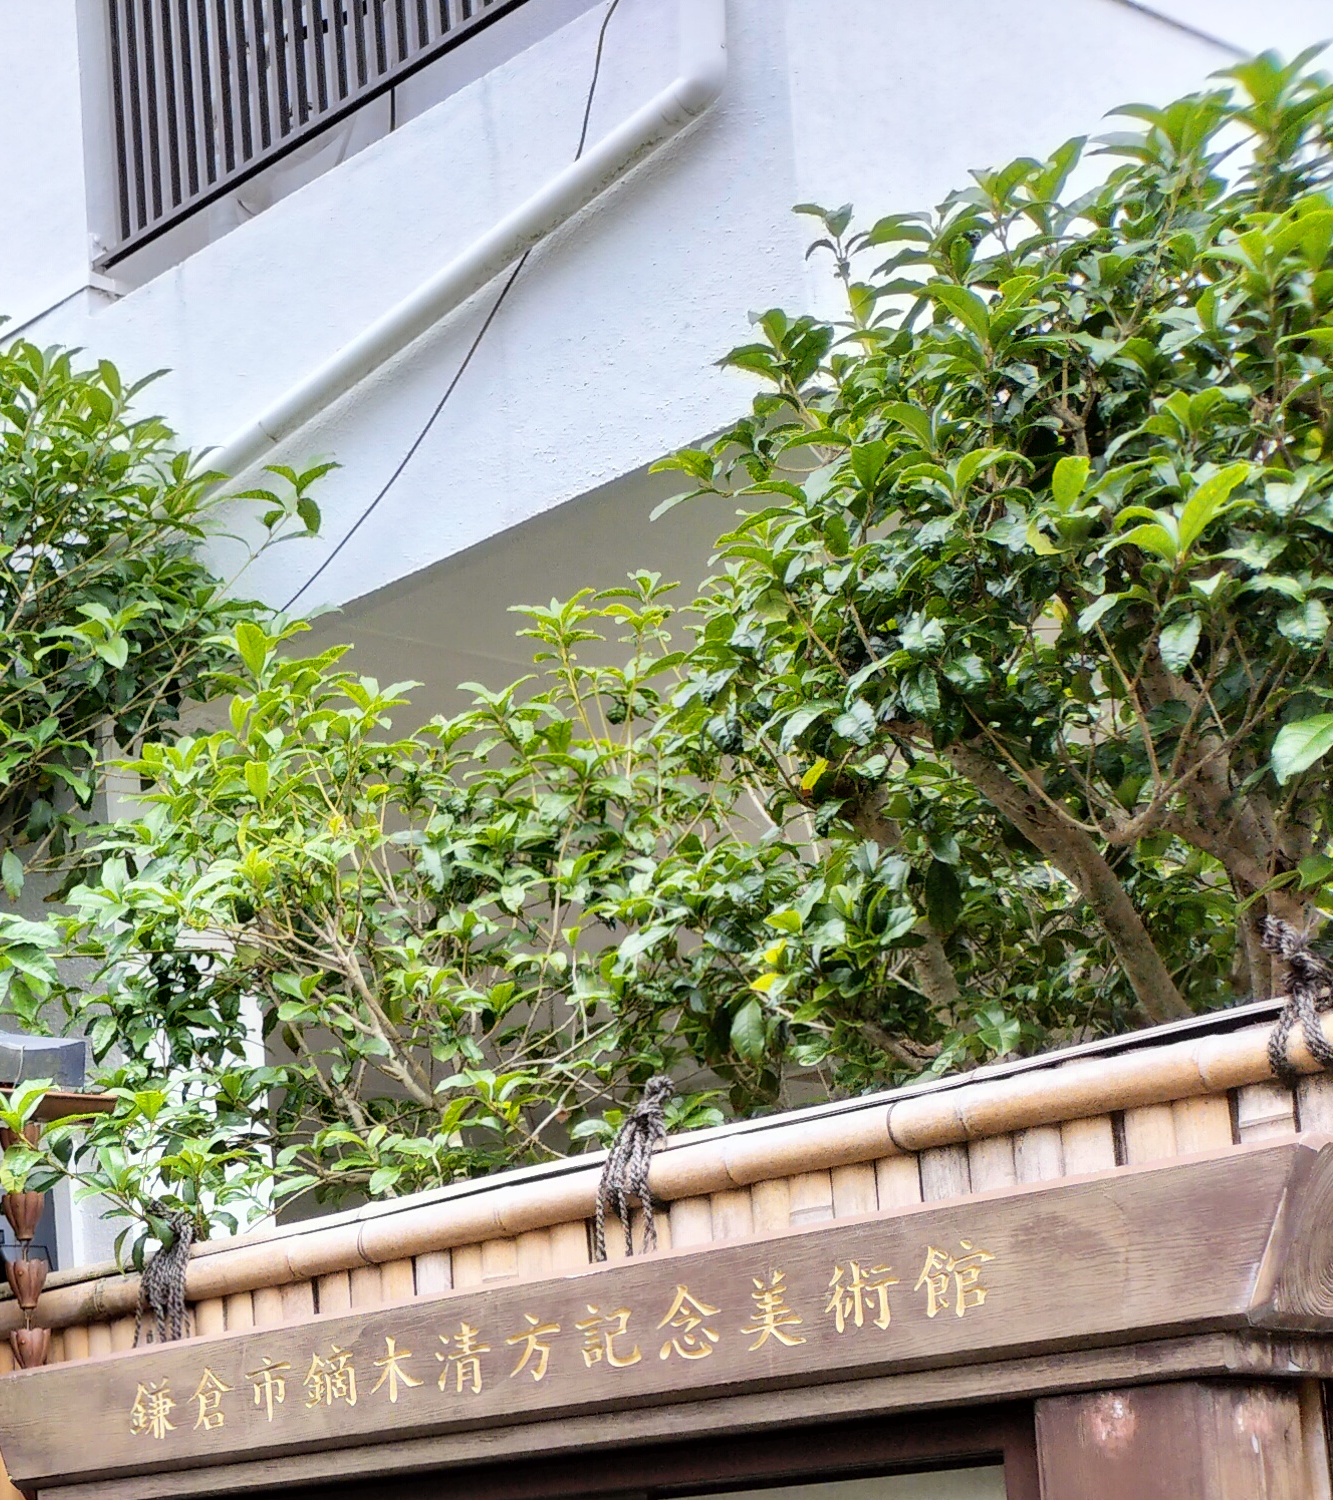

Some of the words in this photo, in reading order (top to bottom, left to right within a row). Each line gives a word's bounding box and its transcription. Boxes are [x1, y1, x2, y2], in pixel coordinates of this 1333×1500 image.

[130, 1239, 996, 1441] 鎌倉市鏑木清方記念美術館
